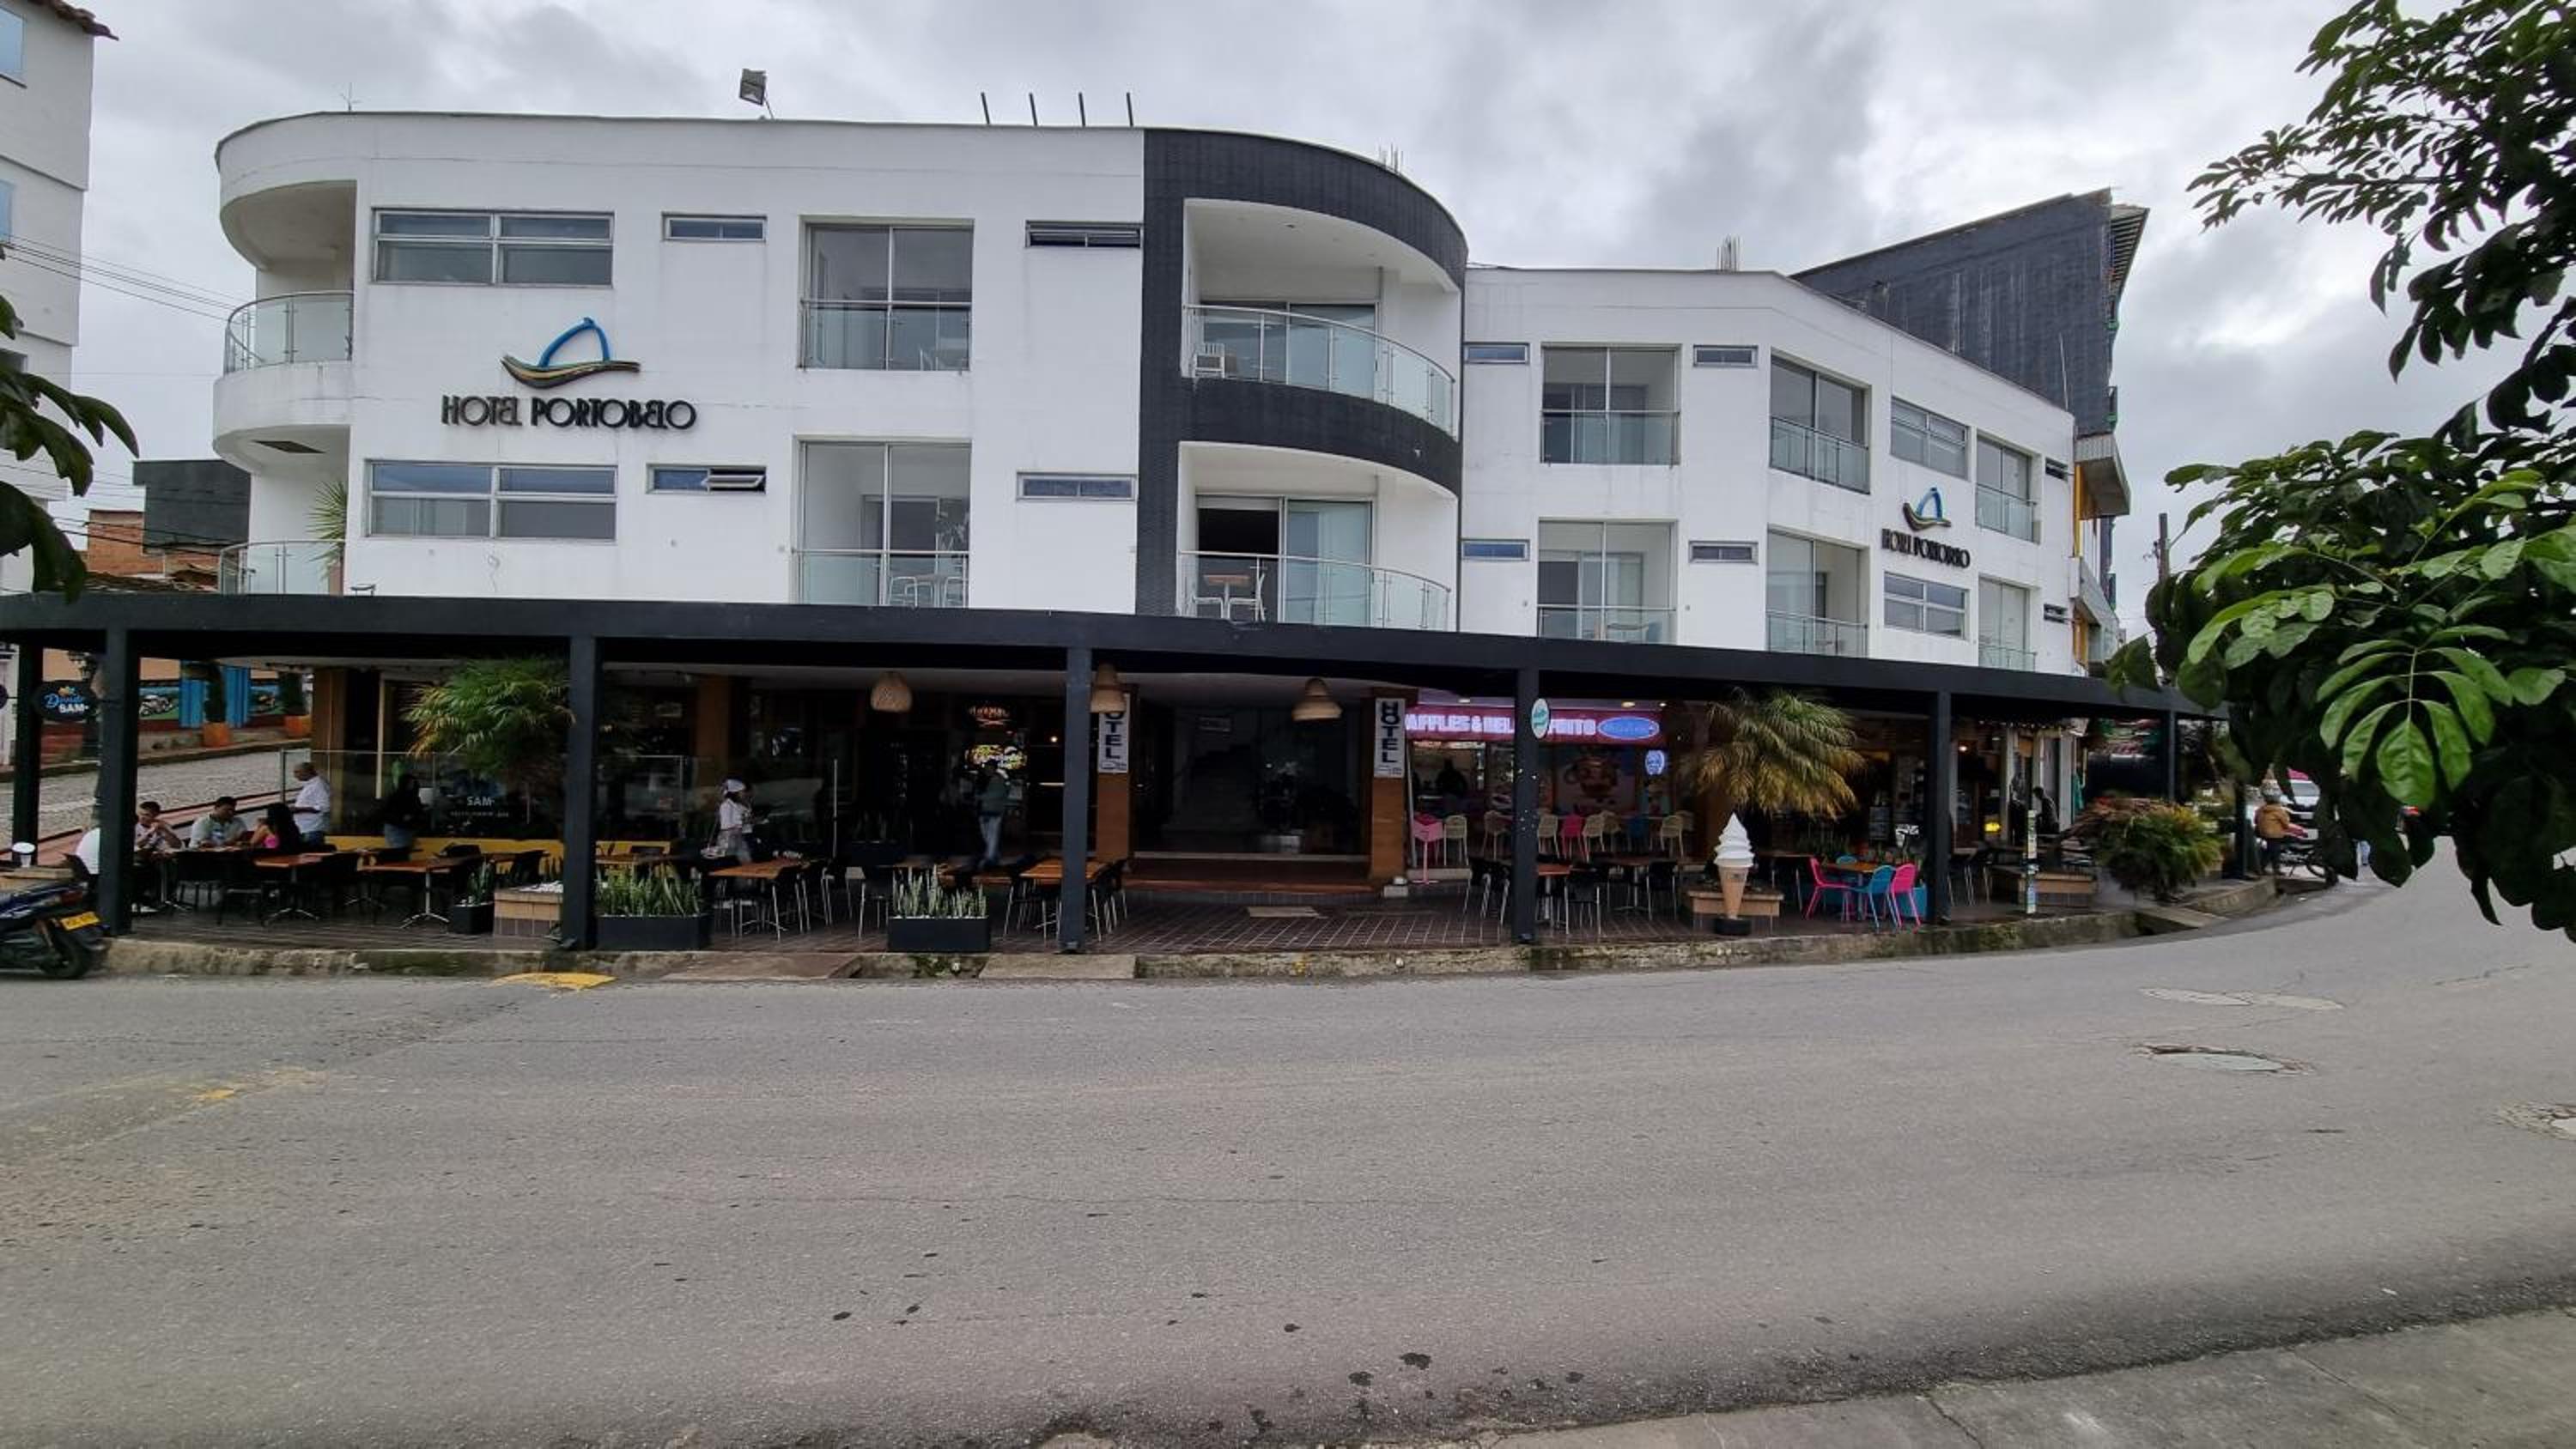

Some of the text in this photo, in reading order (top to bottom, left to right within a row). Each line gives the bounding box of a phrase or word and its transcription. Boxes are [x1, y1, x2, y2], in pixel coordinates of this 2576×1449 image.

[441, 395, 697, 429] HOTEL PORTOBELO
[1381, 700, 1400, 763] HOTEL
